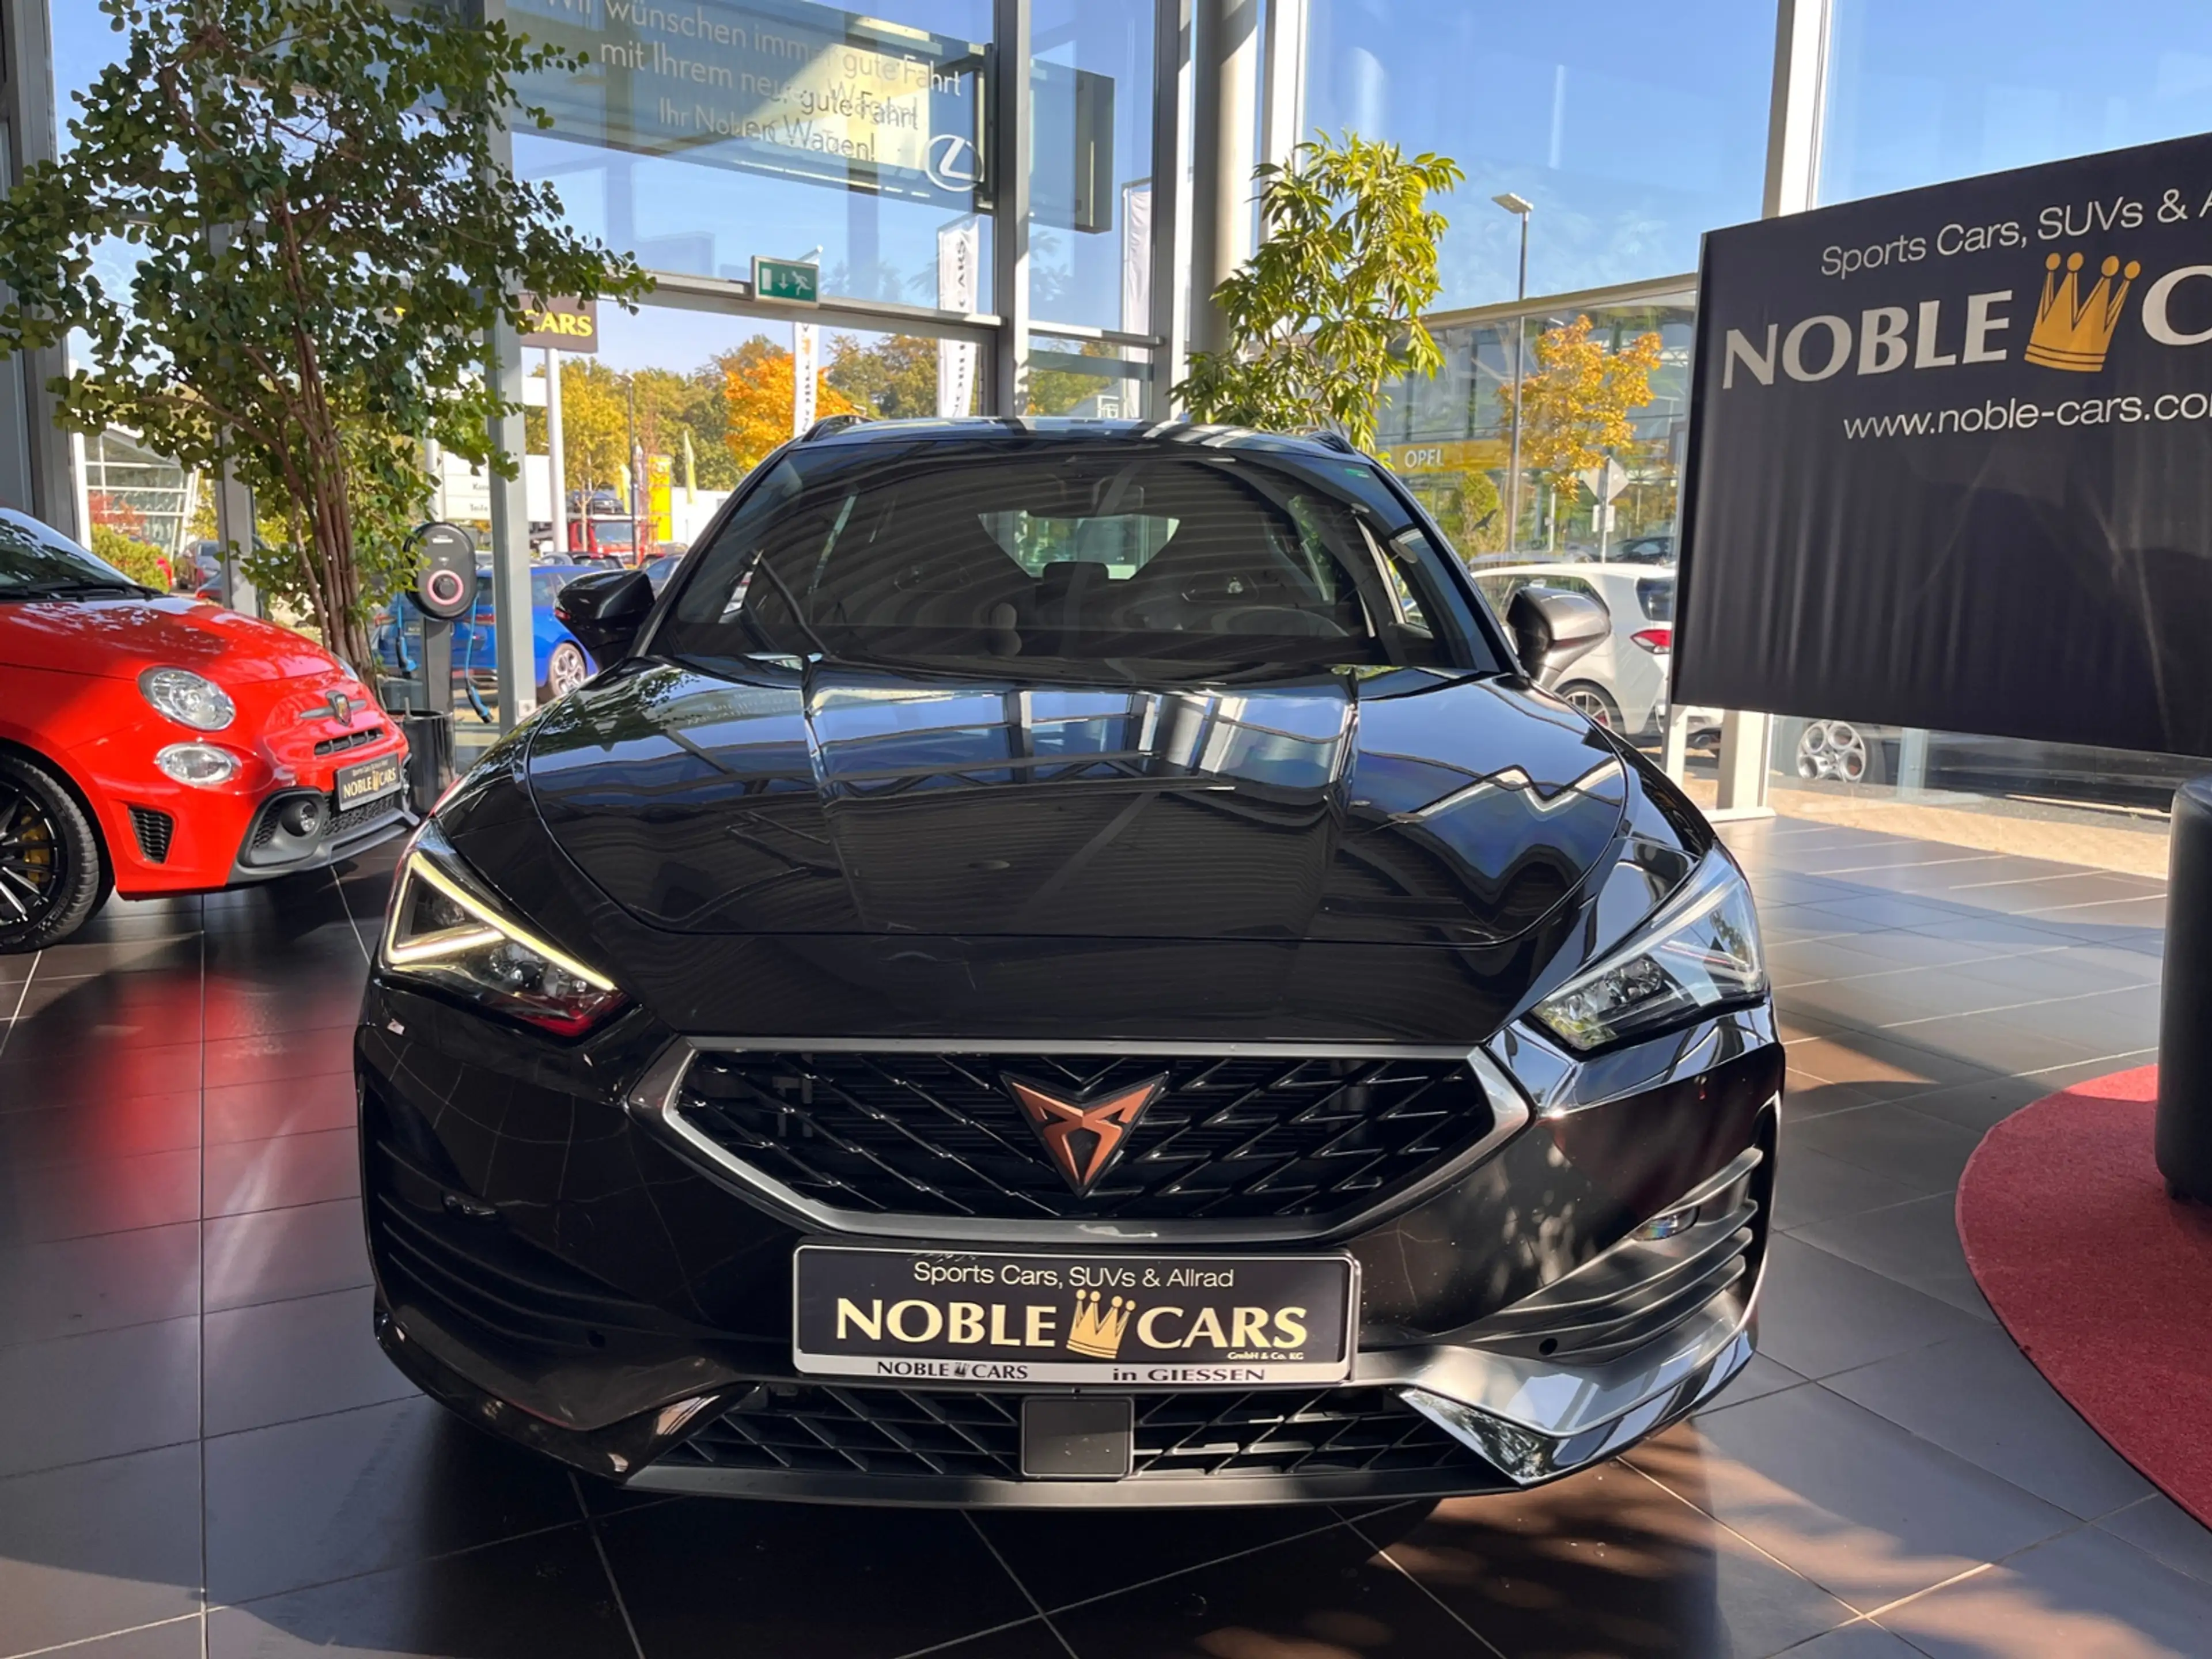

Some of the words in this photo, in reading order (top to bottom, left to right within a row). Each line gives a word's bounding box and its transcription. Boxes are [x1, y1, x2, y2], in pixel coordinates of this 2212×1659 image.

[601, 40, 645, 71] mit
[654, 40, 732, 89] Ihrem
[903, 54, 961, 97] Fahrt
[1820, 234, 1927, 280] Sports
[1937, 221, 2028, 256] Cars,
[2037, 196, 2143, 241] SUVs
[2157, 188, 2188, 223] &
[1722, 289, 2013, 389] NOBLE
[1843, 393, 2212, 440] www.noble-cars.co
[343, 776, 372, 799] NOBLE
[914, 1261, 995, 1286] Sports
[1001, 1264, 1063, 1290] Cars,
[1069, 1266, 1137, 1288] SUVs
[1142, 1268, 1161, 1287] &
[1166, 1268, 1234, 1288] Allrad
[836, 1297, 1057, 1347] NOBLE
[1137, 1306, 1308, 1349] CARS
[877, 1361, 950, 1377] NOBLE
[971, 1364, 1029, 1380] CARS
[1112, 1368, 1137, 1381] in
[1147, 1368, 1266, 1382] GIESSEN
